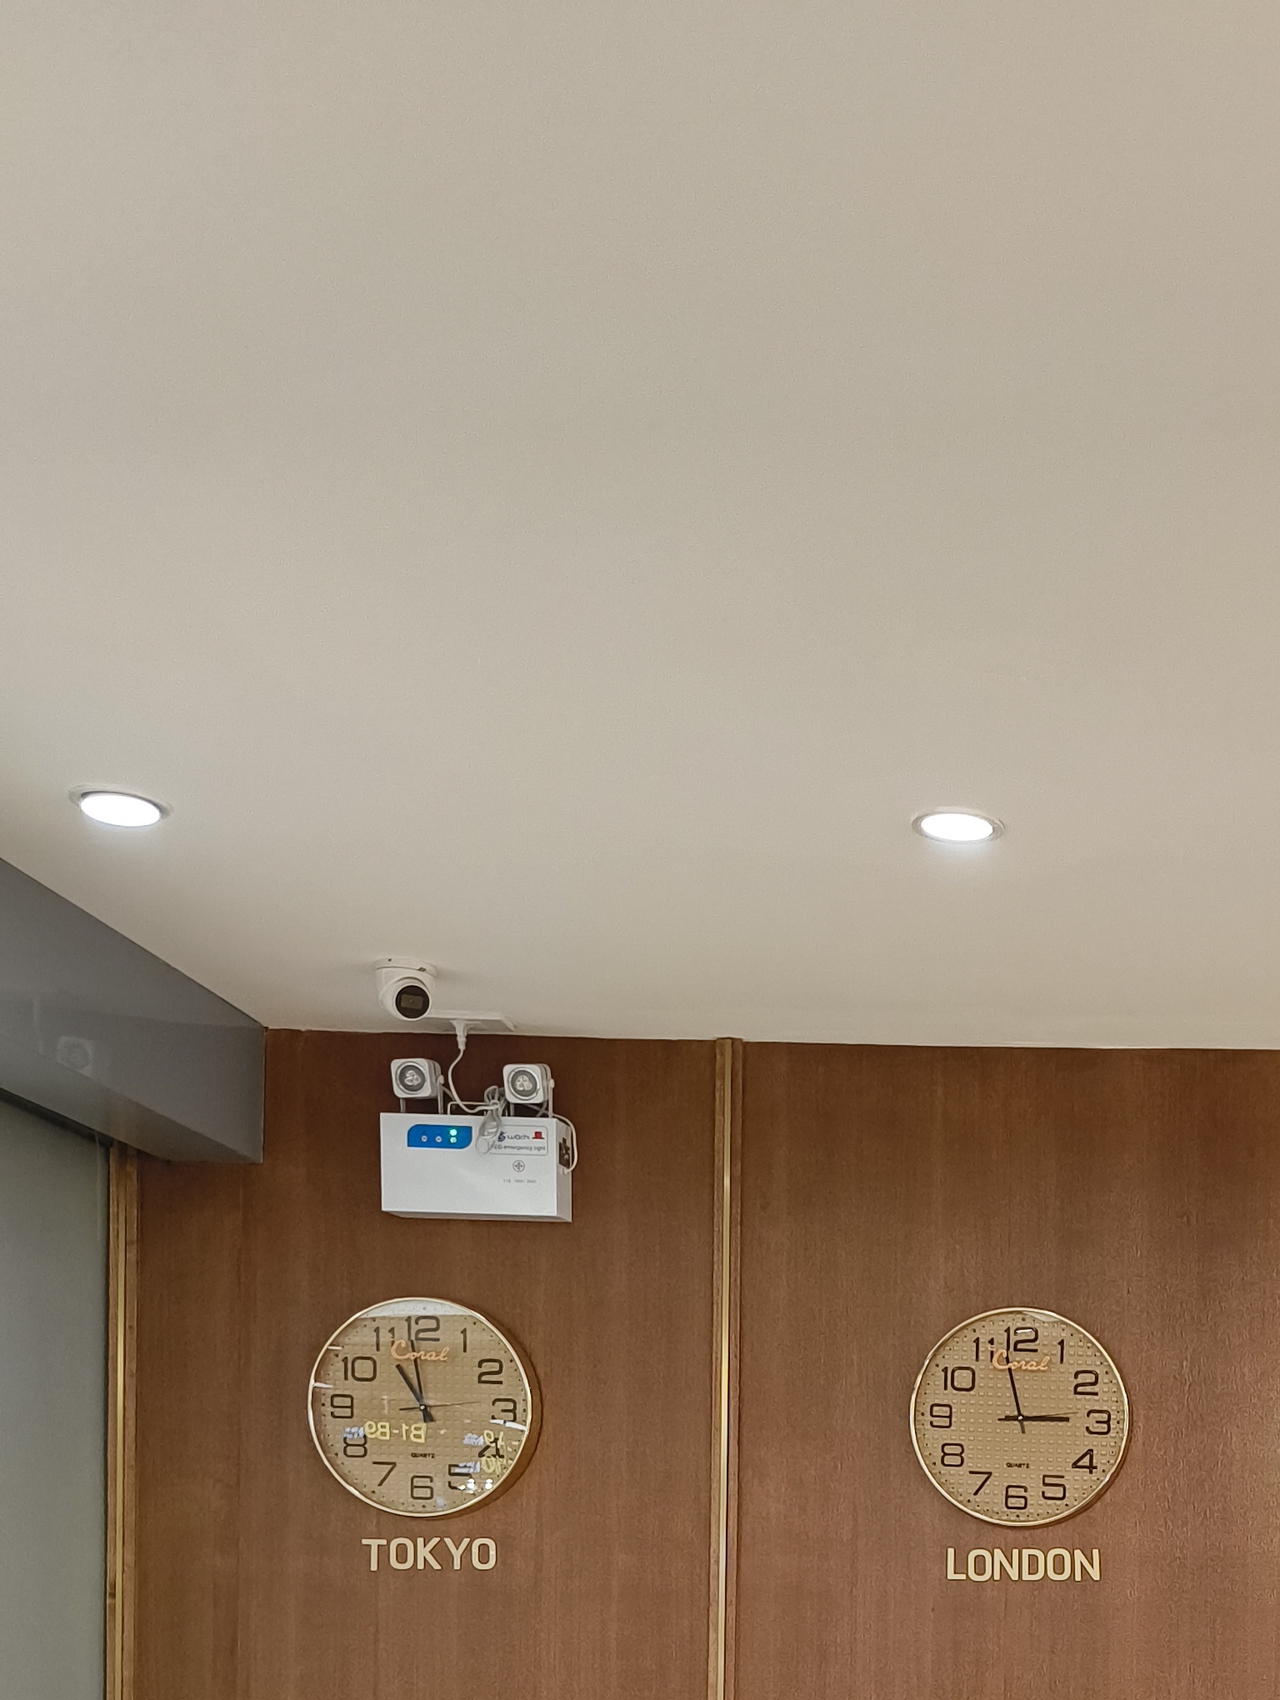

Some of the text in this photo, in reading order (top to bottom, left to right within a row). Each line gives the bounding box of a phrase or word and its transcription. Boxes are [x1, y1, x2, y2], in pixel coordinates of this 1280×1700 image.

[374, 1327, 395, 1351] 11
[405, 1316, 440, 1341] 12
[461, 1328, 467, 1352] 1
[1005, 1327, 1038, 1352] 12
[390, 1340, 449, 1361] Coral
[973, 1337, 994, 1362] 11
[991, 1349, 1050, 1370] Coral
[1058, 1339, 1065, 1364] 1
[341, 1356, 377, 1382] 10
[477, 1359, 503, 1384] 2
[941, 1367, 976, 1392] 10
[1074, 1370, 1099, 1396] 2
[330, 1394, 354, 1418] 9
[492, 1398, 517, 1422] 3
[930, 1403, 952, 1428] 9
[1086, 1409, 1111, 1435] 3
[941, 1443, 965, 1467] 8
[1072, 1449, 1097, 1474] 4
[372, 1462, 397, 1486] 7
[968, 1471, 992, 1496] 7
[411, 1475, 433, 1499] 6
[1005, 1485, 1027, 1510] 6
[1042, 1475, 1066, 1500] 5
[361, 1537, 497, 1571] TOKYO
[947, 1548, 1100, 1581] LONDON
